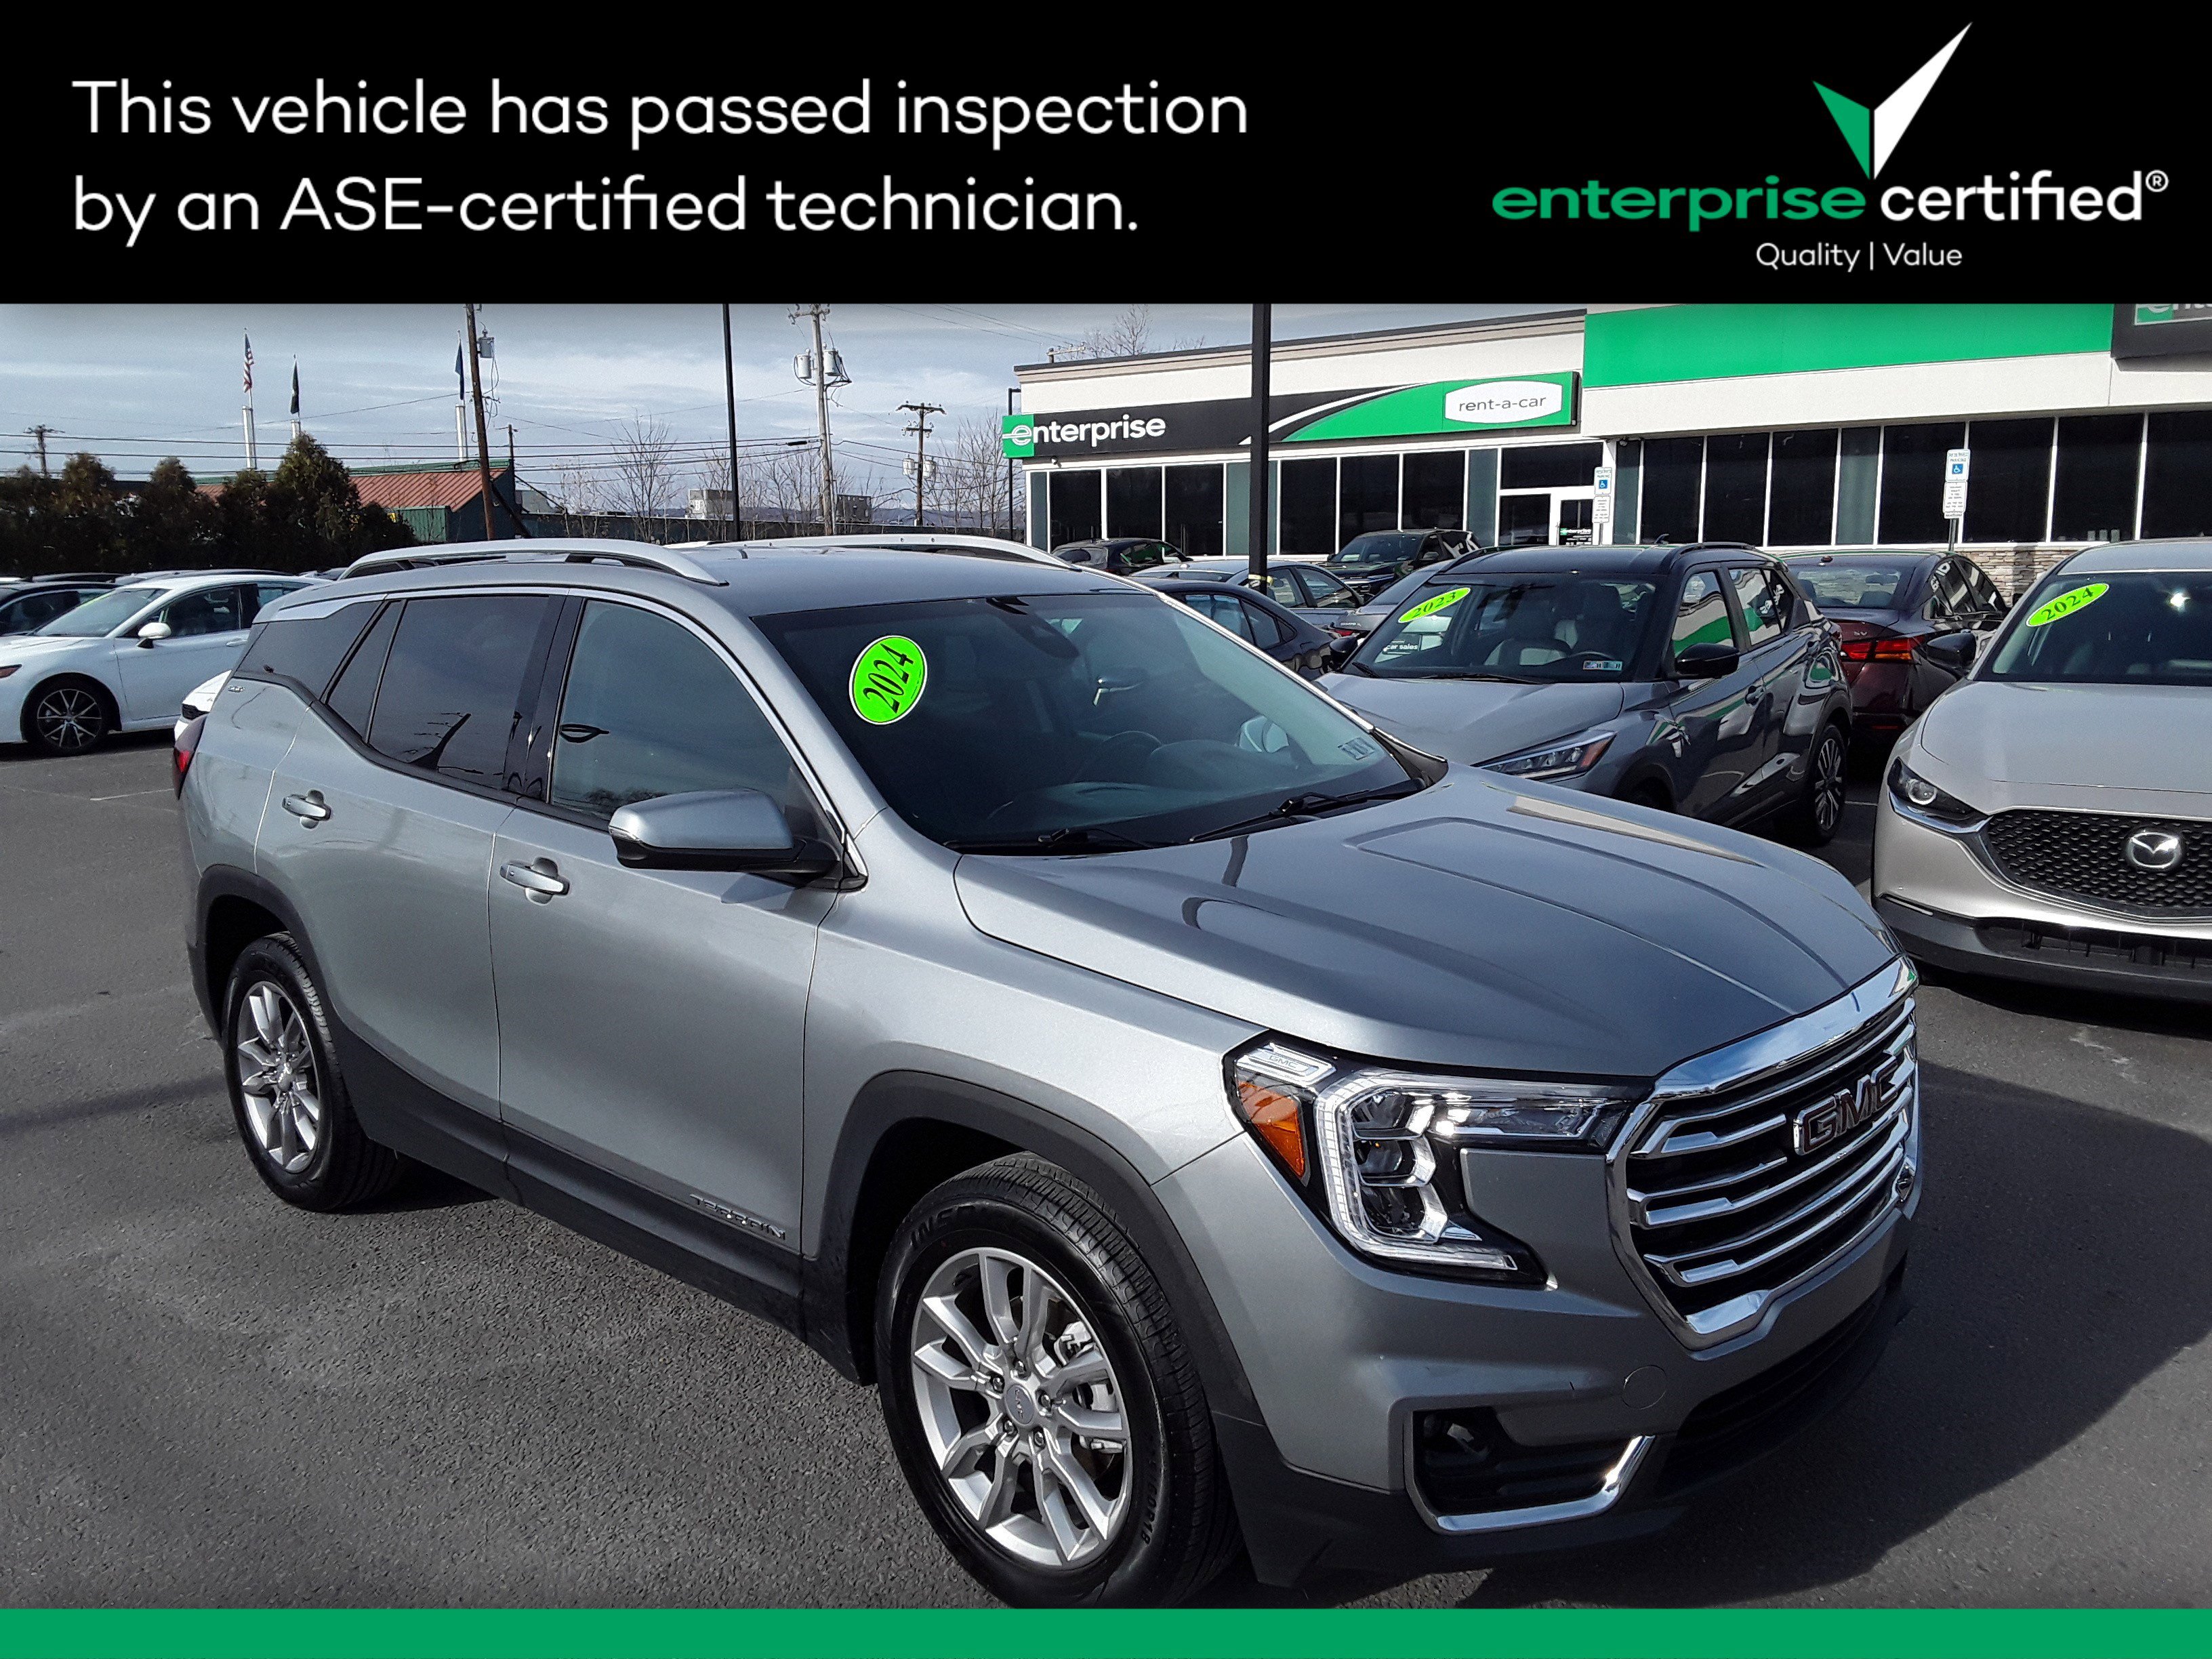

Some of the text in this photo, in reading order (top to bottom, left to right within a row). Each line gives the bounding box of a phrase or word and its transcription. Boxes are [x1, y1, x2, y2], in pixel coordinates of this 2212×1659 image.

[1458, 396, 1547, 411] rent-a-car
[1003, 414, 1166, 447] enterprise
[1411, 592, 1456, 618] 2023
[2041, 587, 2094, 621] 2024
[862, 642, 914, 714] 2024
[1269, 1054, 1298, 1069] GMC
[1794, 1054, 1898, 1156] GMC
[689, 1193, 786, 1240] TERRAIN
